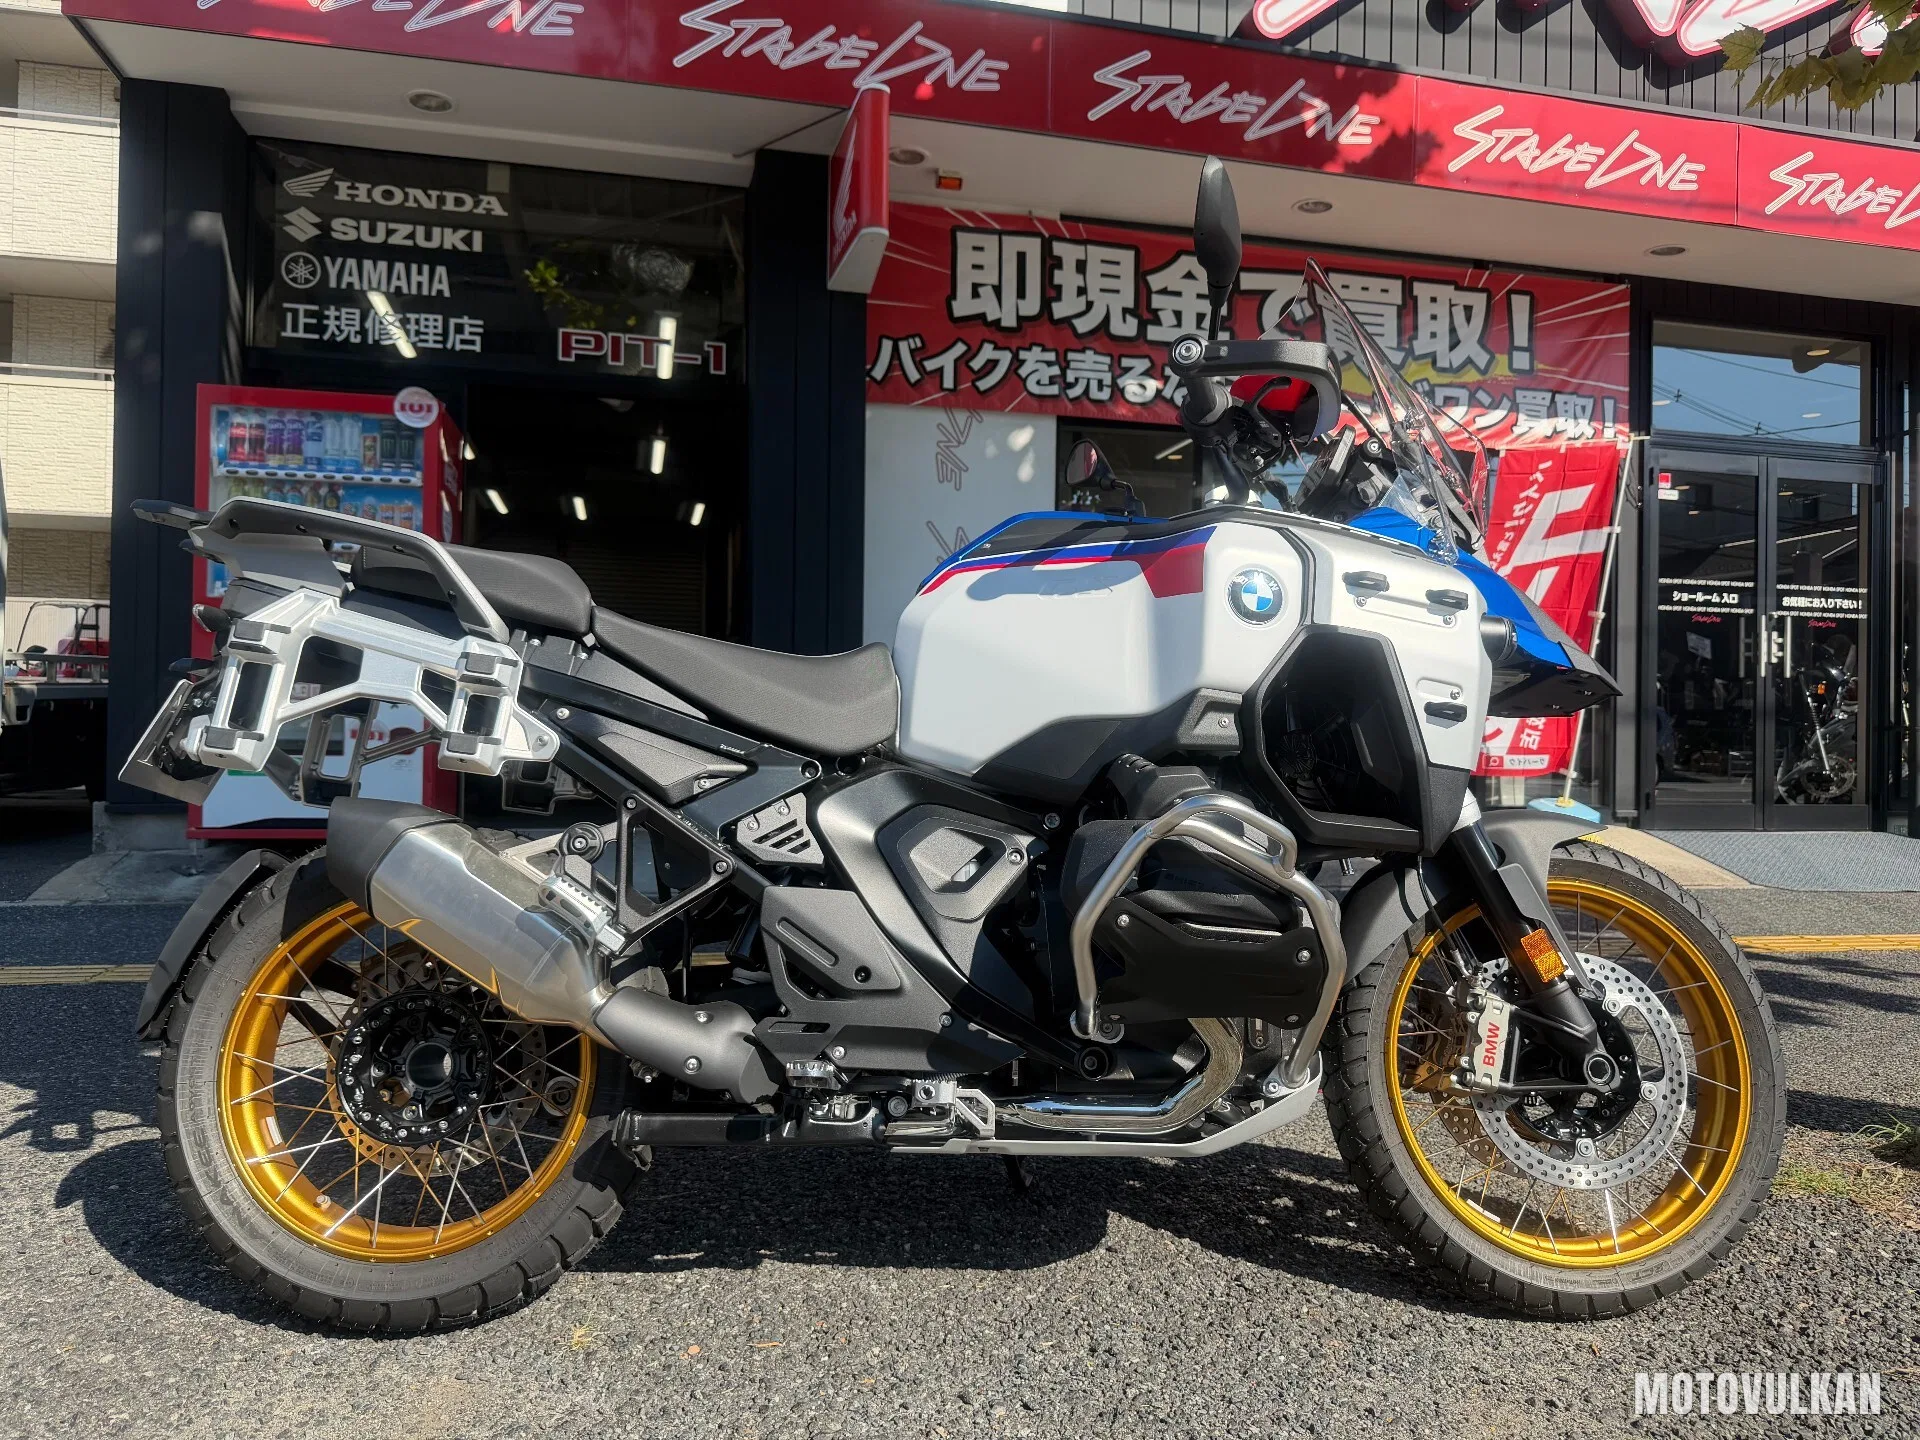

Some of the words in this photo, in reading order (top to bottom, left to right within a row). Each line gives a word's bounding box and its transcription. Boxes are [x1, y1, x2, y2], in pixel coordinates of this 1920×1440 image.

[334, 180, 509, 217] HONDA
[330, 217, 483, 253] SUZUKI
[323, 255, 451, 298] YAMAHA
[281, 302, 485, 353] 正規修理店
[1232, 571, 1279, 591] BMW
[1673, 591, 1720, 602] ショールーム
[1721, 593, 1739, 604] 入口
[1483, 1021, 1501, 1067] BMW
